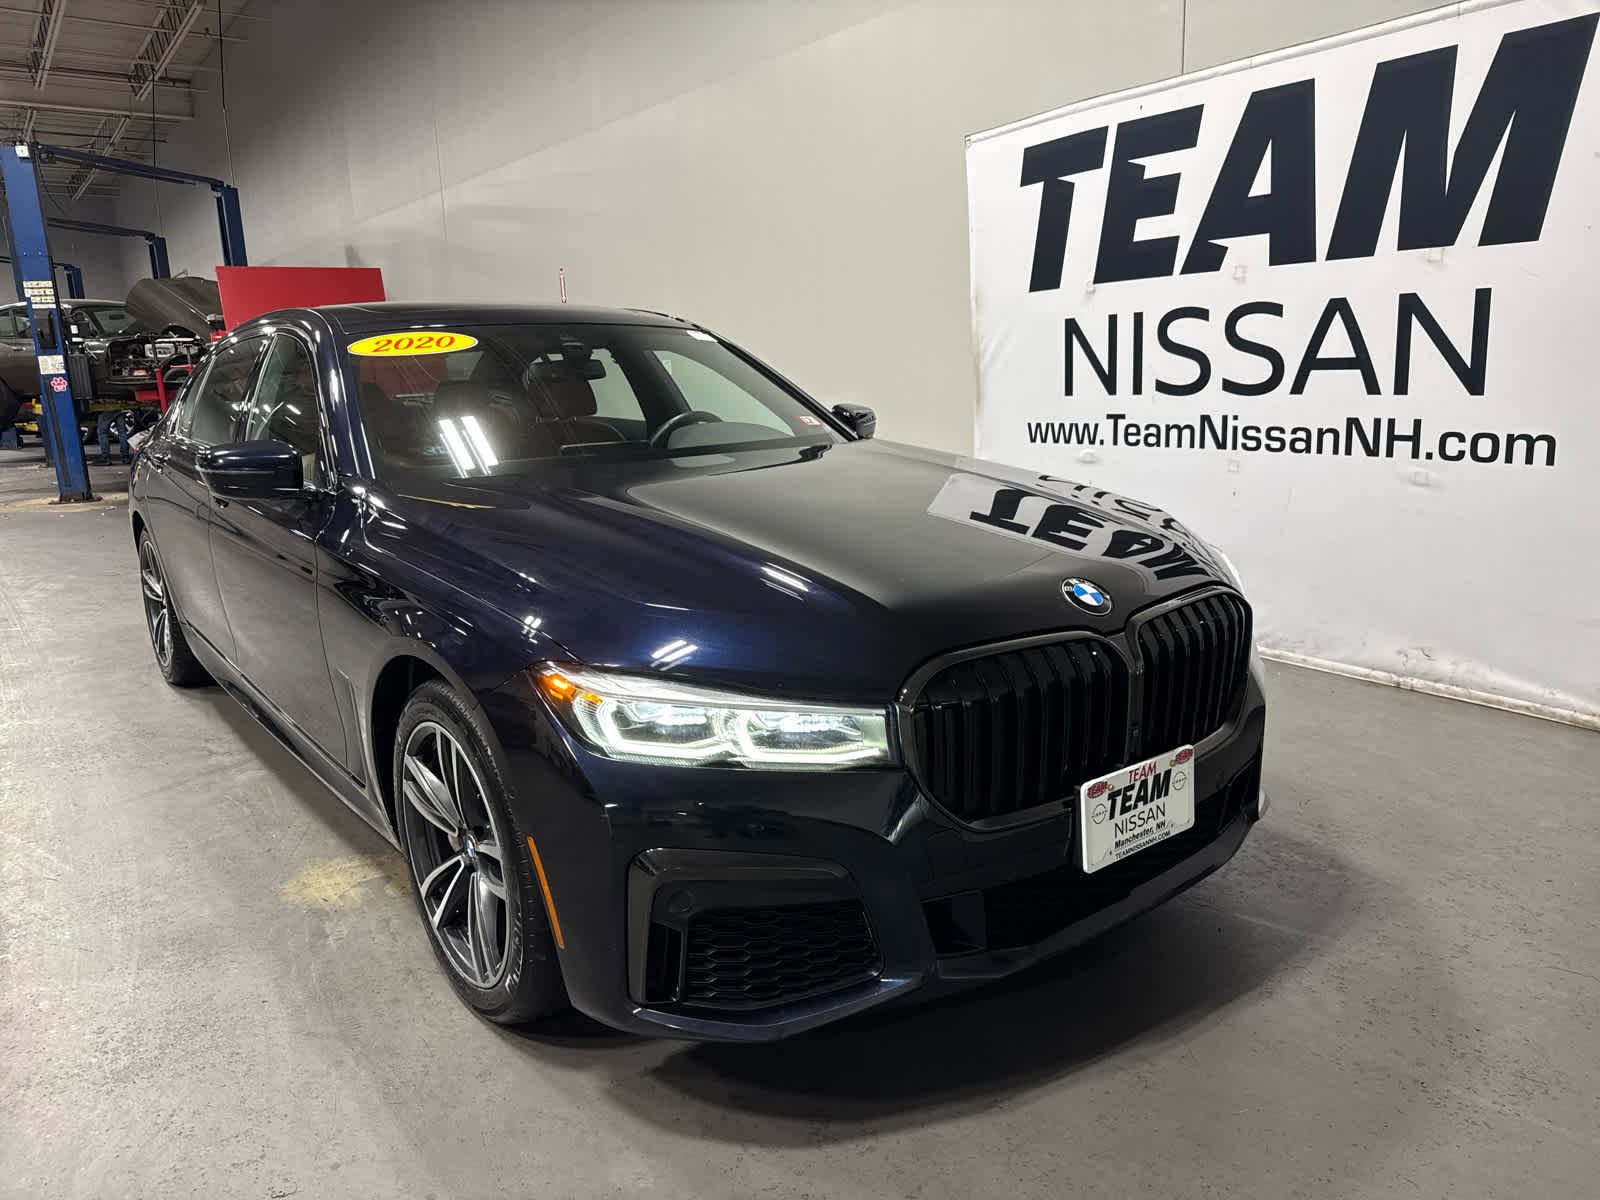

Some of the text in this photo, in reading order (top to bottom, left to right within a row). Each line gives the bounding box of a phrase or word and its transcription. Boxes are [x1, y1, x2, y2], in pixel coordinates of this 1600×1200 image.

[1020, 12, 1600, 293] TEAM
[372, 336, 455, 353] 2020
[1064, 288, 1492, 398] NISSAN
[1027, 414, 1557, 467] www.TeamNissanNH.com
[1107, 768, 1172, 820] TEAM
[1128, 761, 1157, 783] TEAM
[1114, 802, 1166, 838] NISSAN
[1114, 826, 1154, 849] Manchester,
